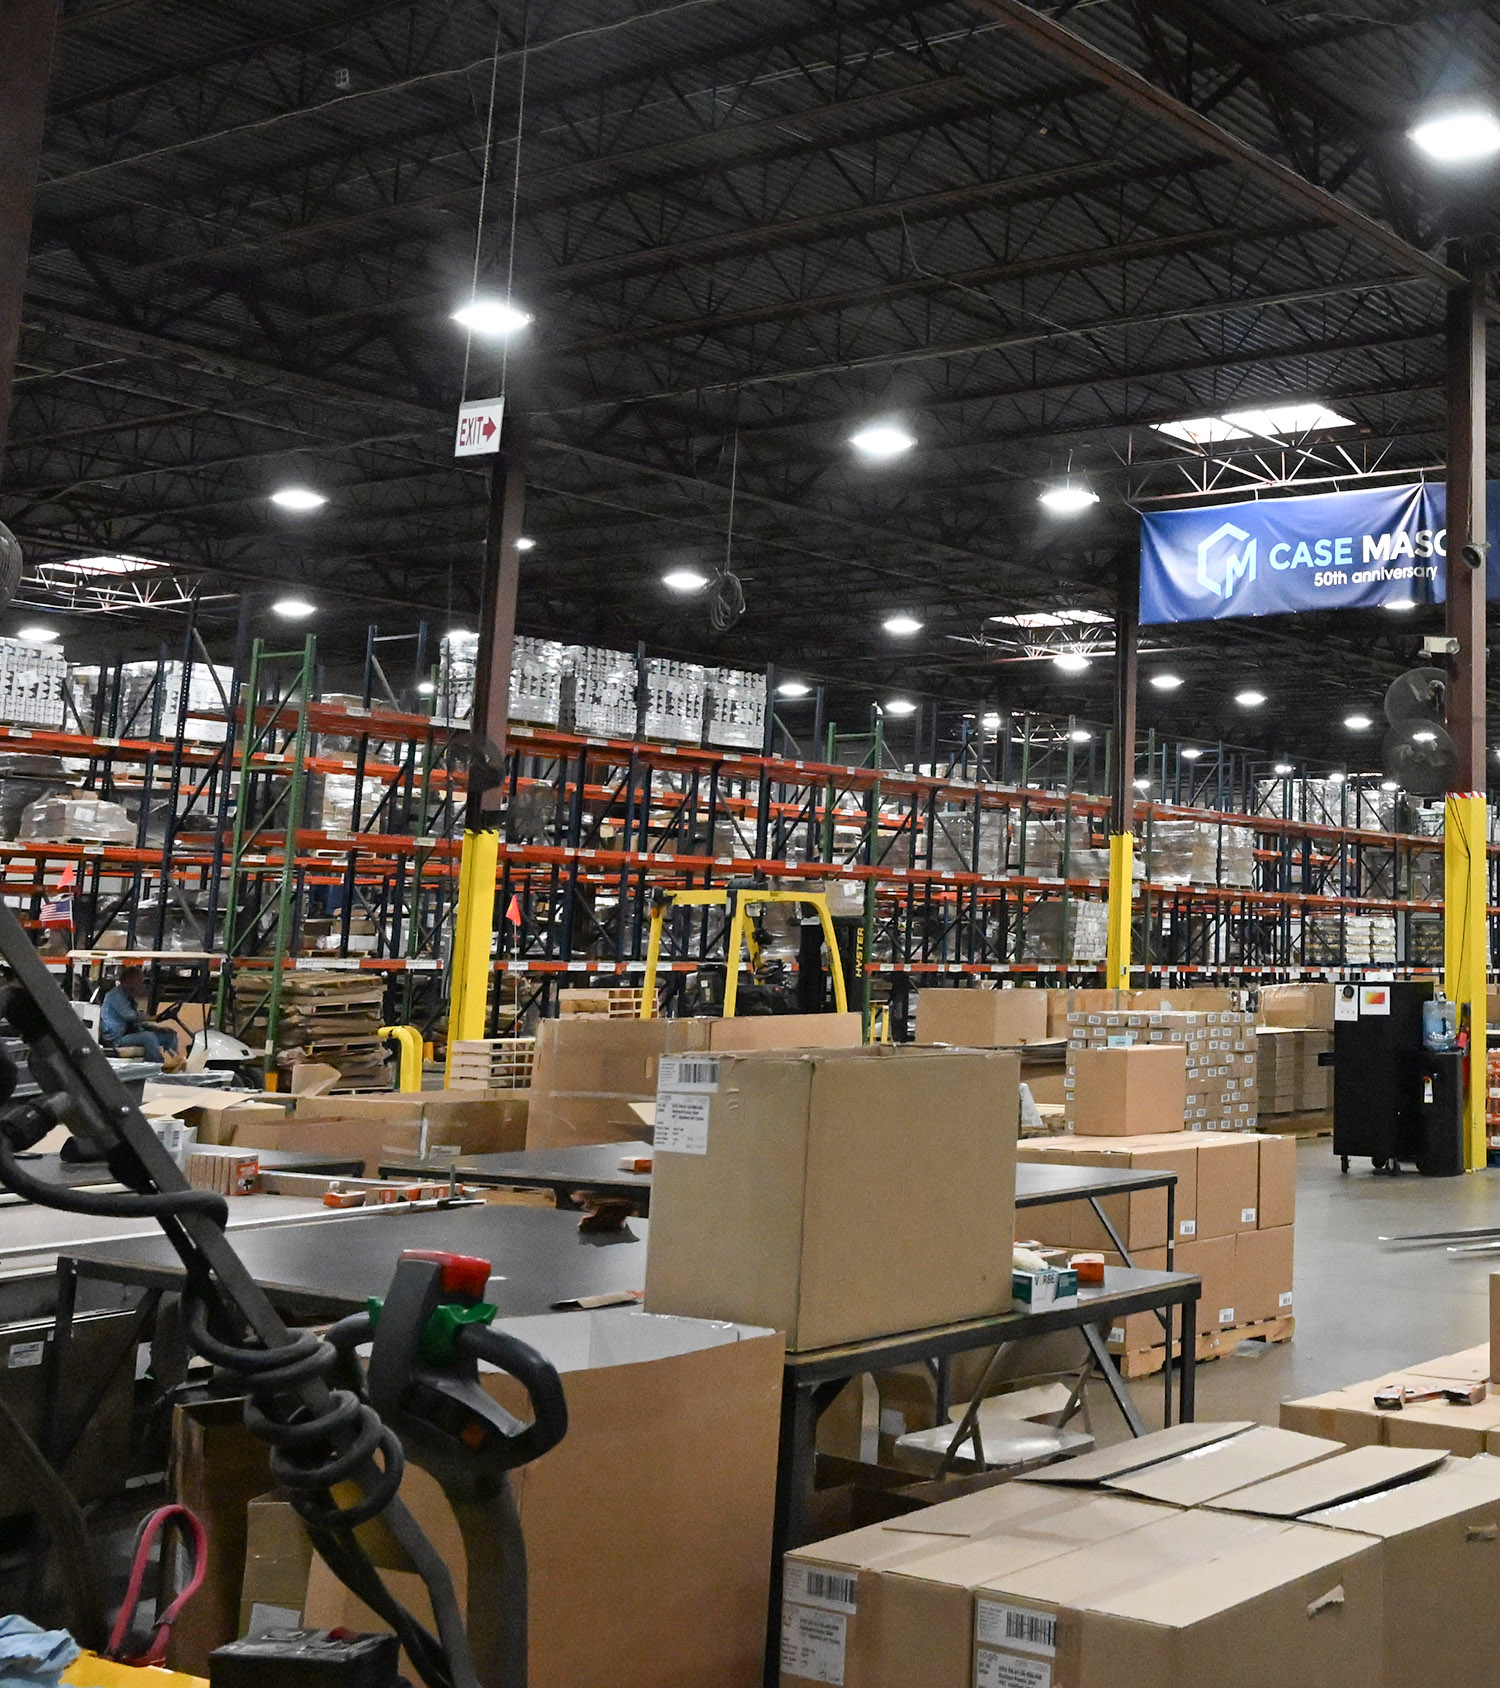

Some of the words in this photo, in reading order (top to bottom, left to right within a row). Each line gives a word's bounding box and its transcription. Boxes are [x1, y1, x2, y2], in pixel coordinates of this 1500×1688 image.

[459, 416, 484, 446] EXIT
[1269, 537, 1353, 571] CASE
[1314, 571, 1348, 587] 50th
[1352, 565, 1438, 585] anniversary
[855, 927, 865, 978] HYSTER
